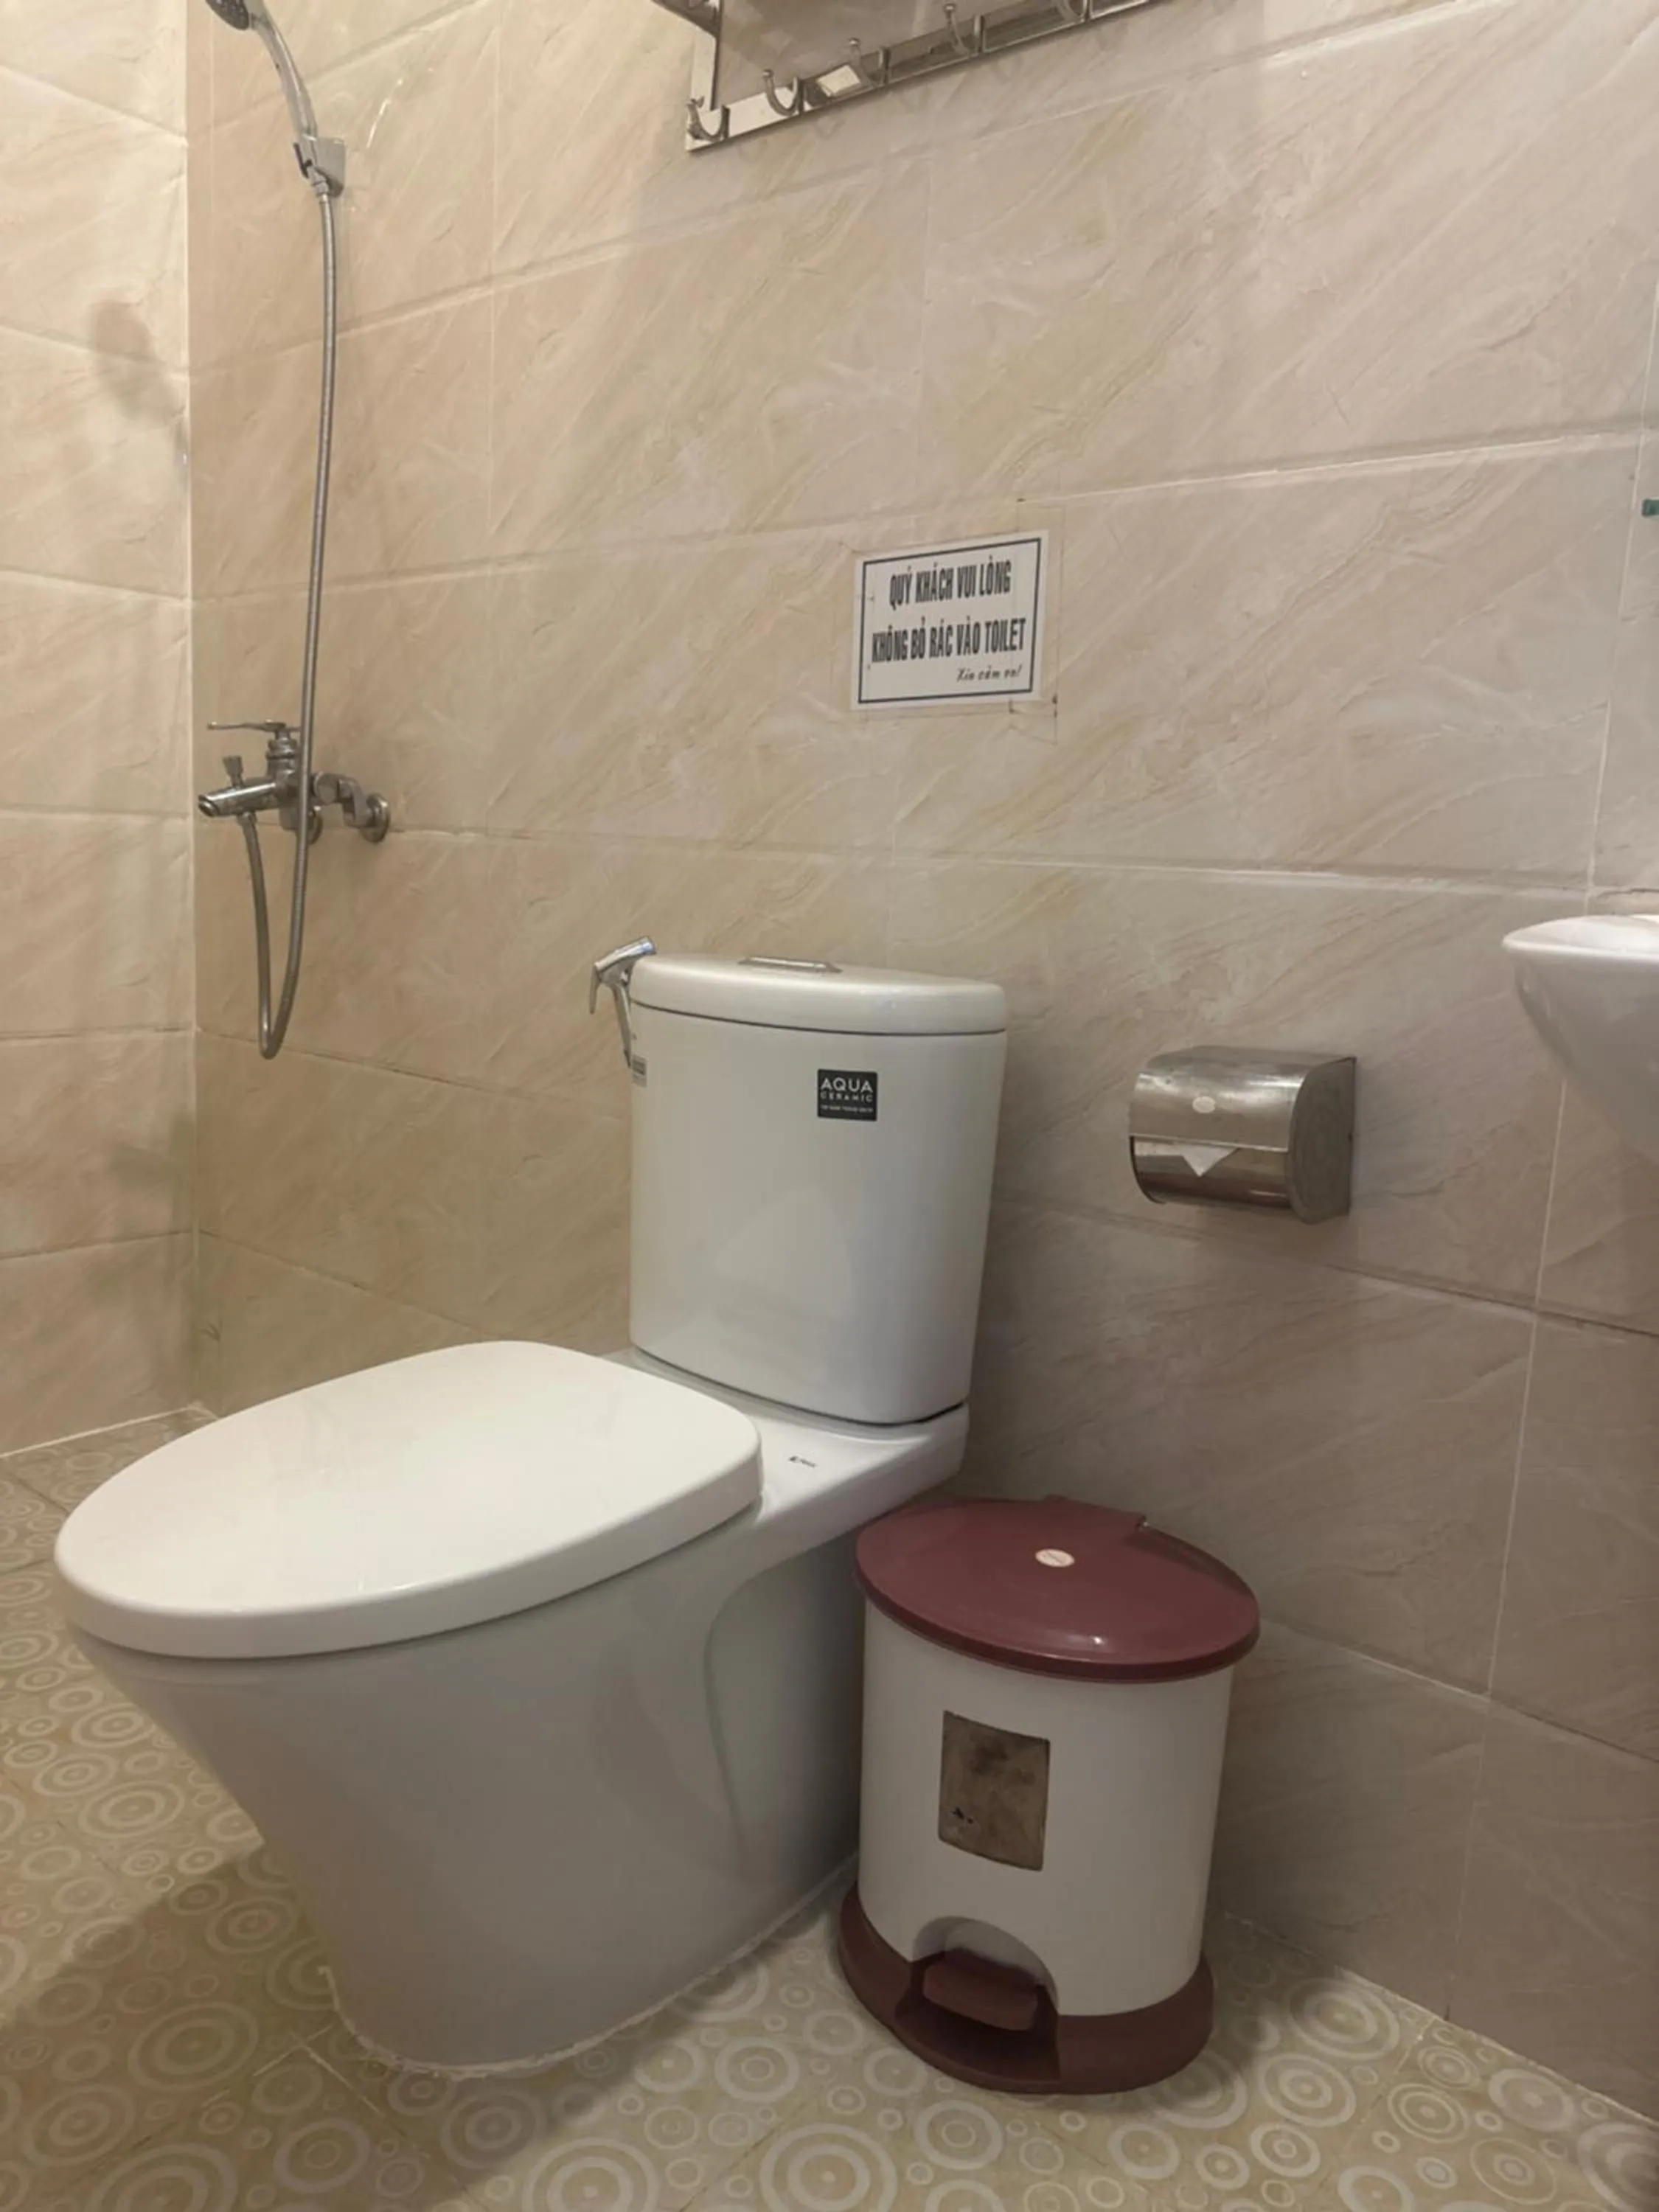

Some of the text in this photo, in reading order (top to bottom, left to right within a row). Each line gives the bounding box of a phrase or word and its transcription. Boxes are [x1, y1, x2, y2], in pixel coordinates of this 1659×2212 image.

[889, 554, 1012, 611] QUÝ KHÁCH VUI LÒNG
[872, 616, 1026, 663] KHÔNG BỎ RÁC VÀO TOILET
[820, 1077, 873, 1093] AQUA
